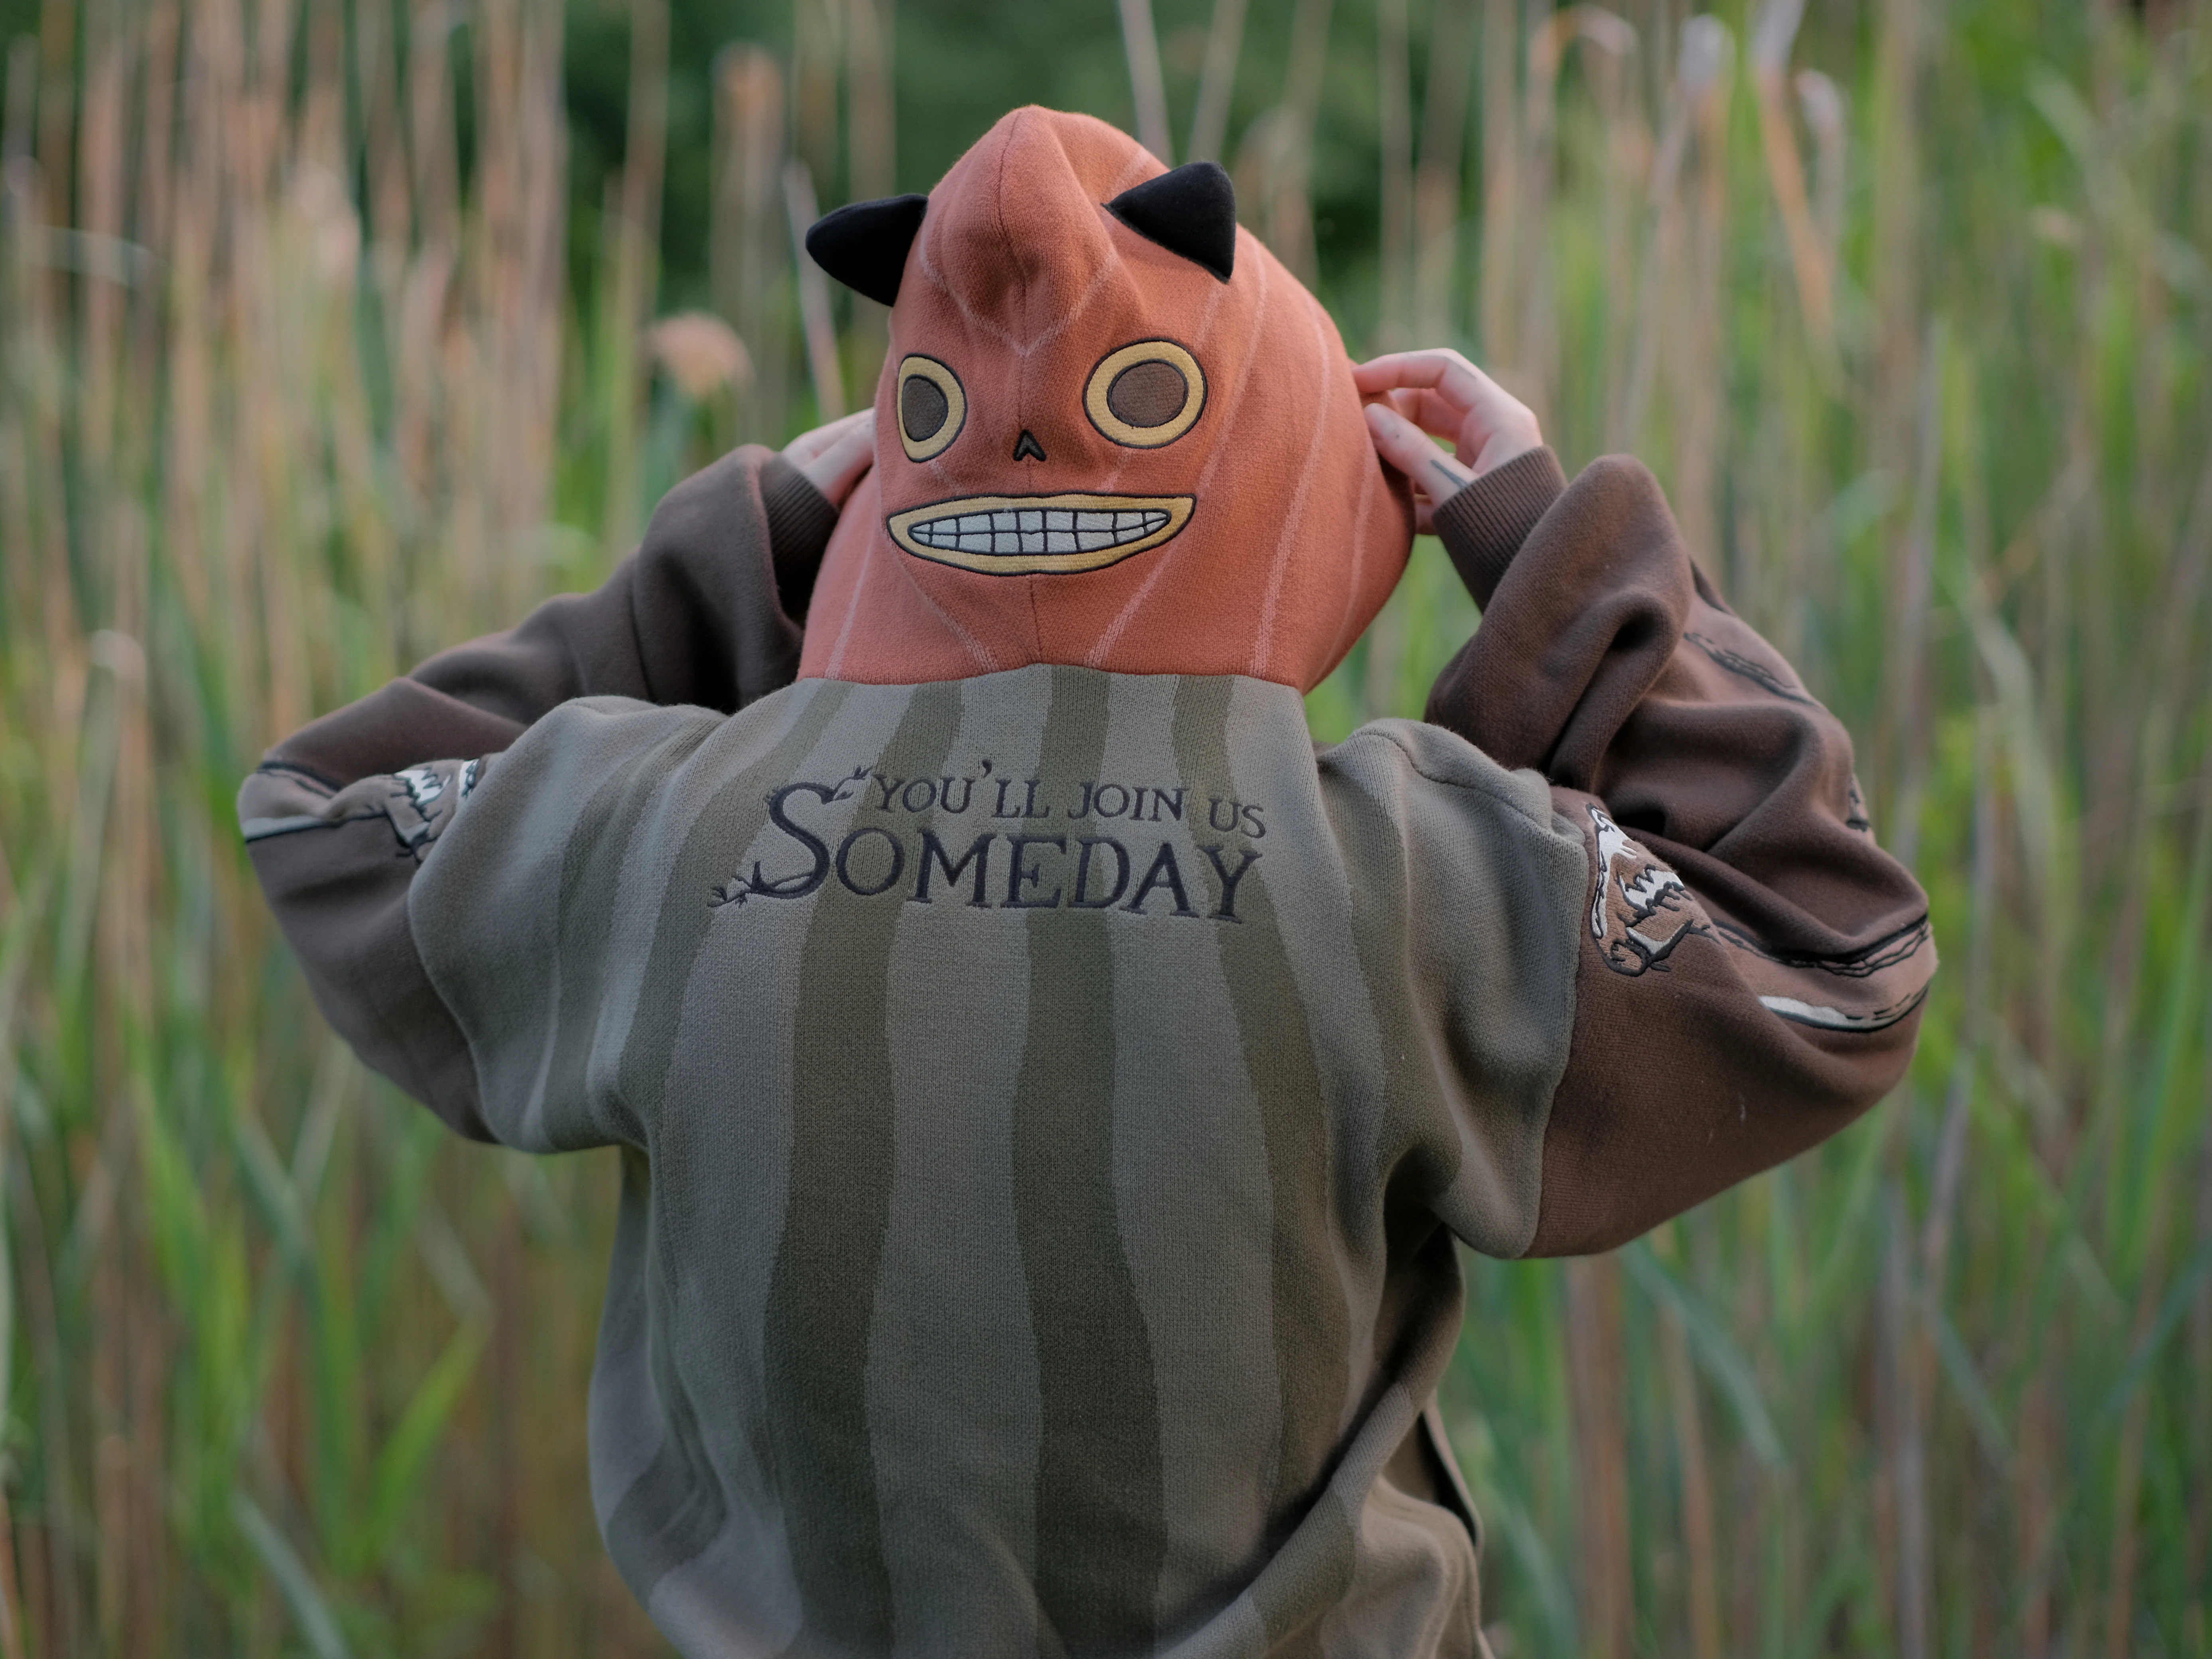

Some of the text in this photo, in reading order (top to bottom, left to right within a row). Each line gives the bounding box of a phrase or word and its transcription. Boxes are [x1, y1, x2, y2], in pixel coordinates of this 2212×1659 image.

[708, 781, 1263, 924] SOMEDAY
[873, 759, 1266, 839] YOU'LL JOIN US
